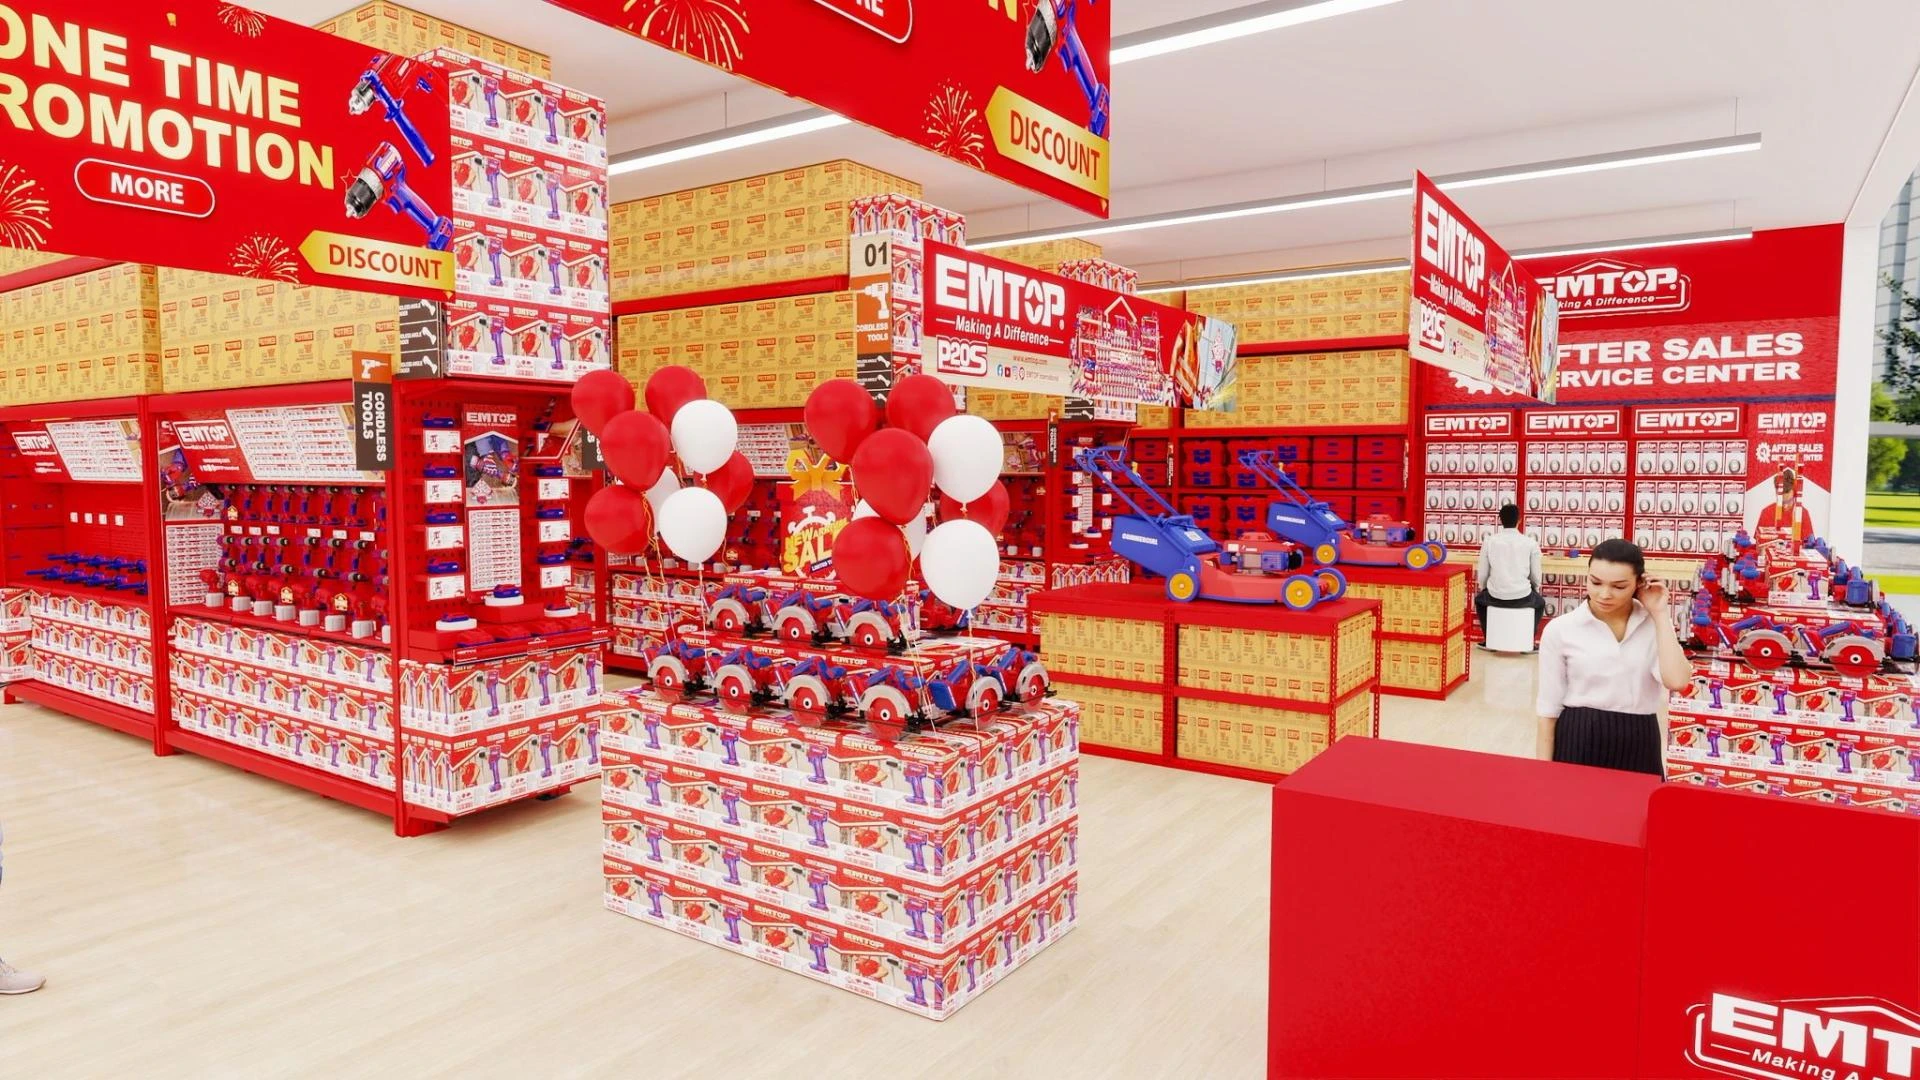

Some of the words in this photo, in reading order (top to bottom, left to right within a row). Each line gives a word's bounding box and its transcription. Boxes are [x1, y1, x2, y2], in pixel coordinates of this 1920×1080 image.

[151, 45, 301, 128] TIME
[1010, 109, 1100, 181] DISCOUNT
[111, 172, 184, 205] MORE
[864, 242, 888, 267] 01
[1420, 191, 1485, 297] EMTOP
[329, 243, 442, 280] DISCOUNT
[935, 253, 1065, 330] EMTOP
[1558, 300, 1581, 310] king
[1595, 295, 1655, 307] Difference
[867, 333, 888, 341] TOOLS
[955, 315, 991, 340] Making
[994, 323, 1002, 337] A
[1004, 325, 1049, 346] Difference
[938, 340, 987, 375] P20S
[1557, 340, 1651, 365] FTER
[1662, 332, 1804, 361] SALES
[1662, 362, 1800, 385] CENTER
[362, 391, 373, 440] TOOLS
[374, 391, 386, 462] CORDLESS
[466, 412, 517, 423] EMTOP
[1429, 416, 1507, 430] EMTOP
[1529, 415, 1615, 429] EMTOP
[1640, 412, 1734, 427] EMTOP
[1758, 412, 1826, 429] EMTOP
[19, 434, 51, 450] EMTOP
[177, 425, 228, 442] EMTOP
[1771, 444, 1797, 453] AFTER
[1798, 443, 1824, 453] SALES
[784, 533, 832, 573] SAL
[1752, 1049, 1835, 1080] Making
